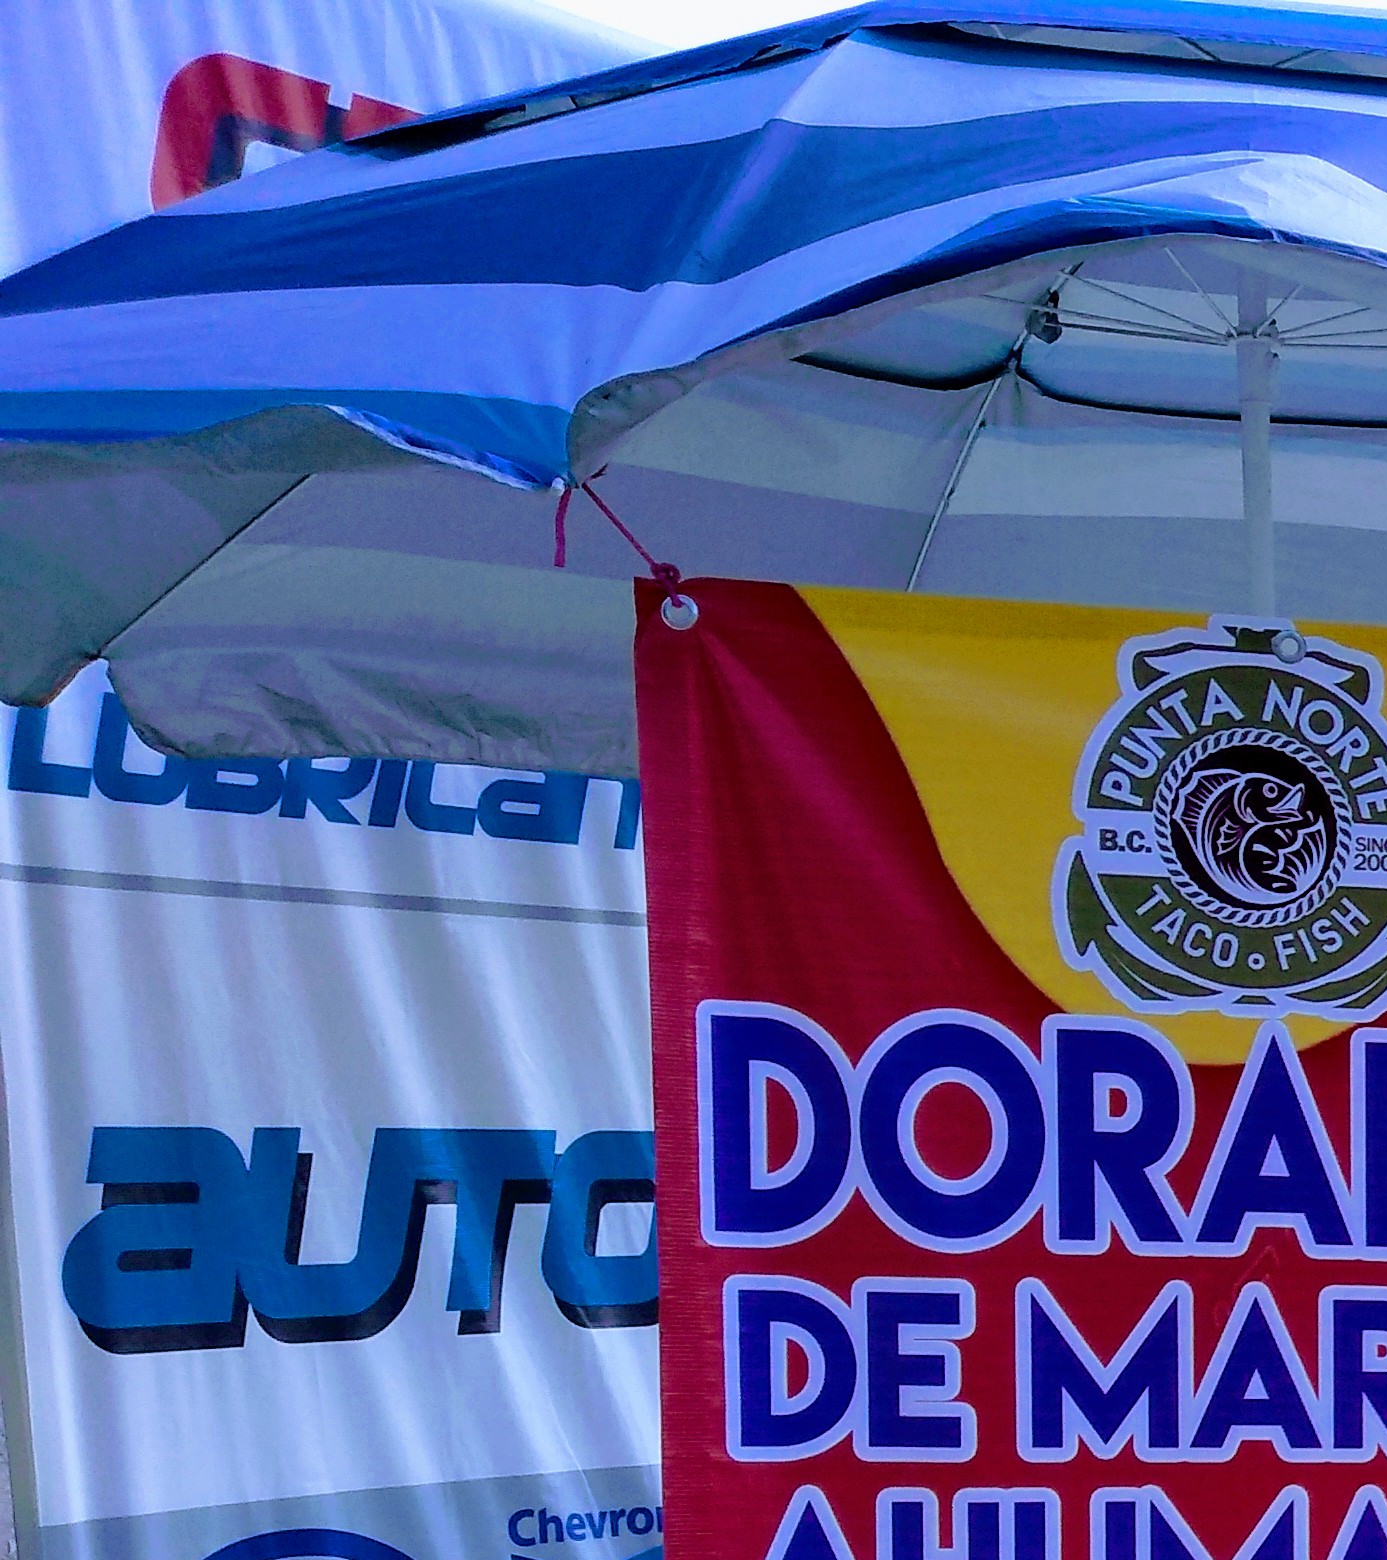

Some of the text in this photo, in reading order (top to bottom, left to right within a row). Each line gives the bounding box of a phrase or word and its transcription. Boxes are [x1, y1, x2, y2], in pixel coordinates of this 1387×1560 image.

[1101, 678, 1242, 807] PUNTA
[1099, 829, 1152, 854] B.C.
[1134, 884, 1371, 972] TACO FISH
[724, 1275, 976, 1461] DE
[508, 1506, 664, 1547] Chevro
